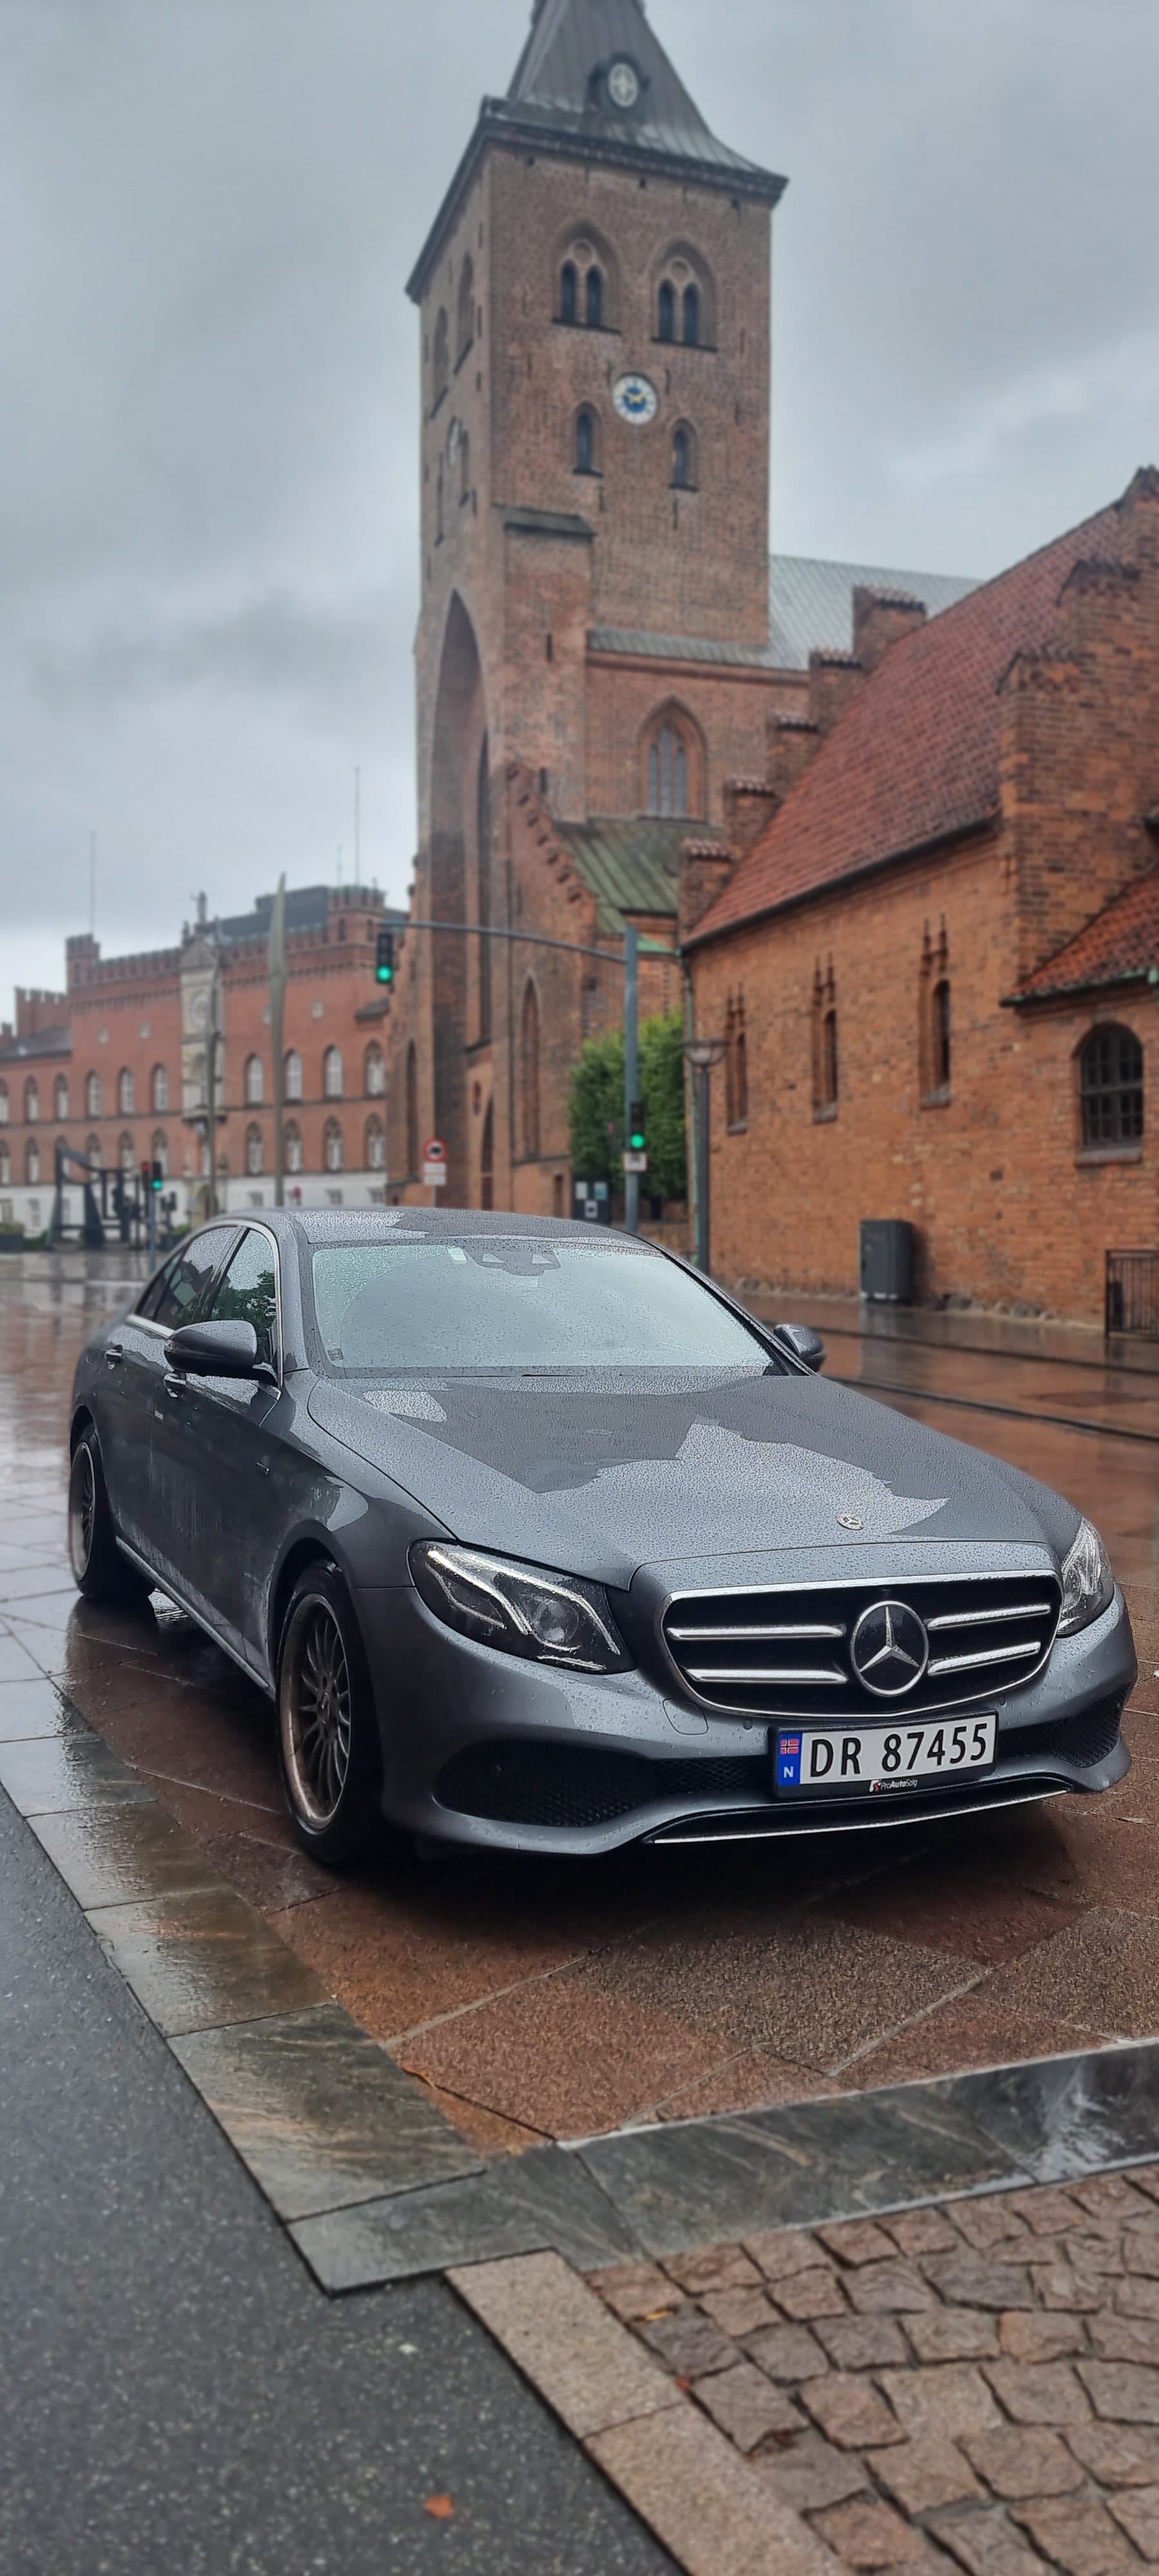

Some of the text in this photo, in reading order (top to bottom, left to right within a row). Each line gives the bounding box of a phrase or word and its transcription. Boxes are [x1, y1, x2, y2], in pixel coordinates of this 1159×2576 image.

[811, 1723, 987, 1777] DR 87455
[784, 1766, 794, 1778] N
